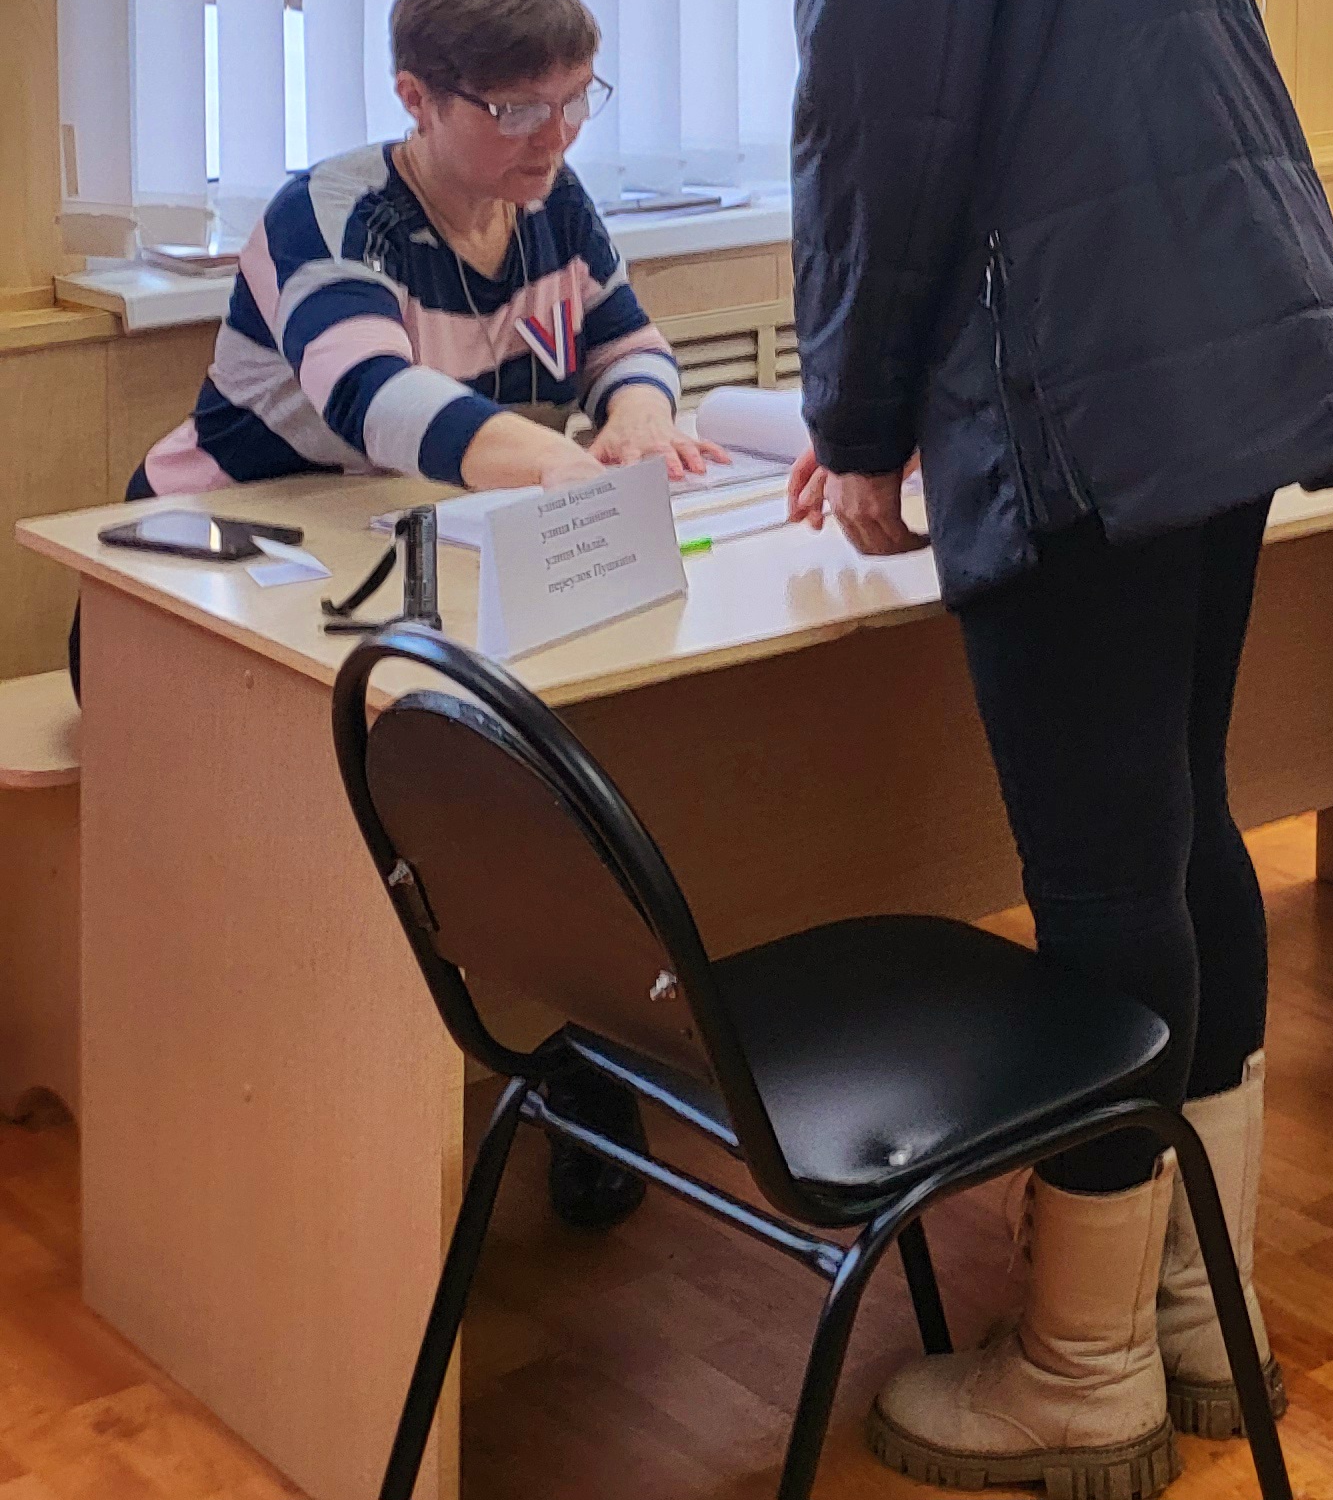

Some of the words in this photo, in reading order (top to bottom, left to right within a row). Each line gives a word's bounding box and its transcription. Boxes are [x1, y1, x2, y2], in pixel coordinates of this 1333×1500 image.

[537, 498, 567, 517] улица
[540, 523, 570, 544] улица
[545, 549, 575, 570] улица
[549, 570, 592, 593] переулок
[594, 553, 637, 577] Пушкина
